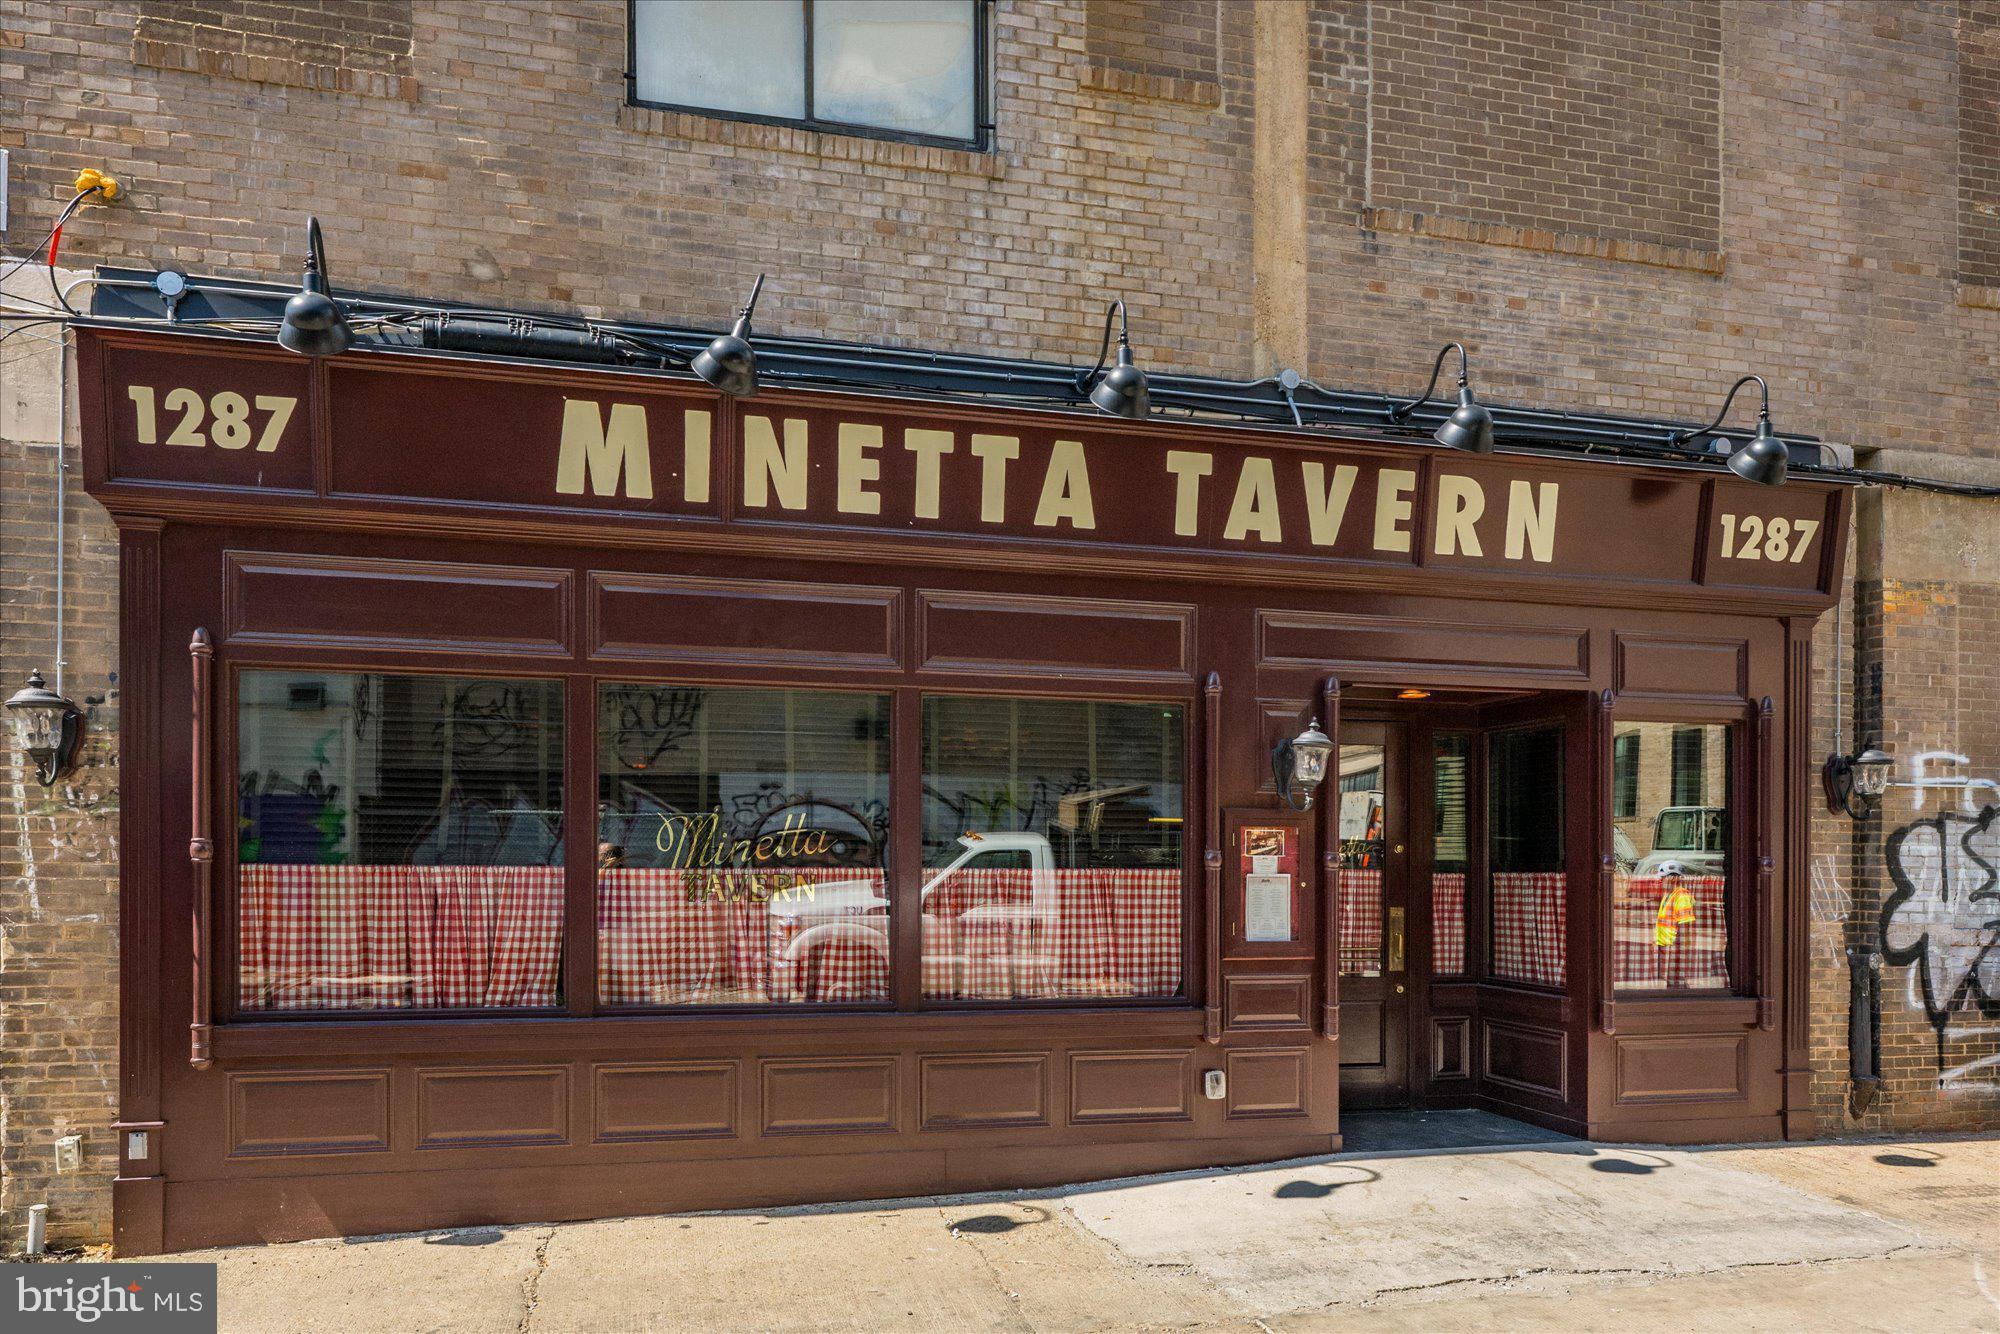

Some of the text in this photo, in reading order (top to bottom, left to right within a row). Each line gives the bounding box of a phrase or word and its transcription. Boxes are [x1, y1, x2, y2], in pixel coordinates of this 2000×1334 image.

[128, 385, 298, 453] 1287
[556, 399, 1559, 563] MINETTA TAVERN
[1720, 513, 1820, 563] 1287
[656, 812, 839, 870] Minetta
[680, 873, 817, 902] TAVERN
